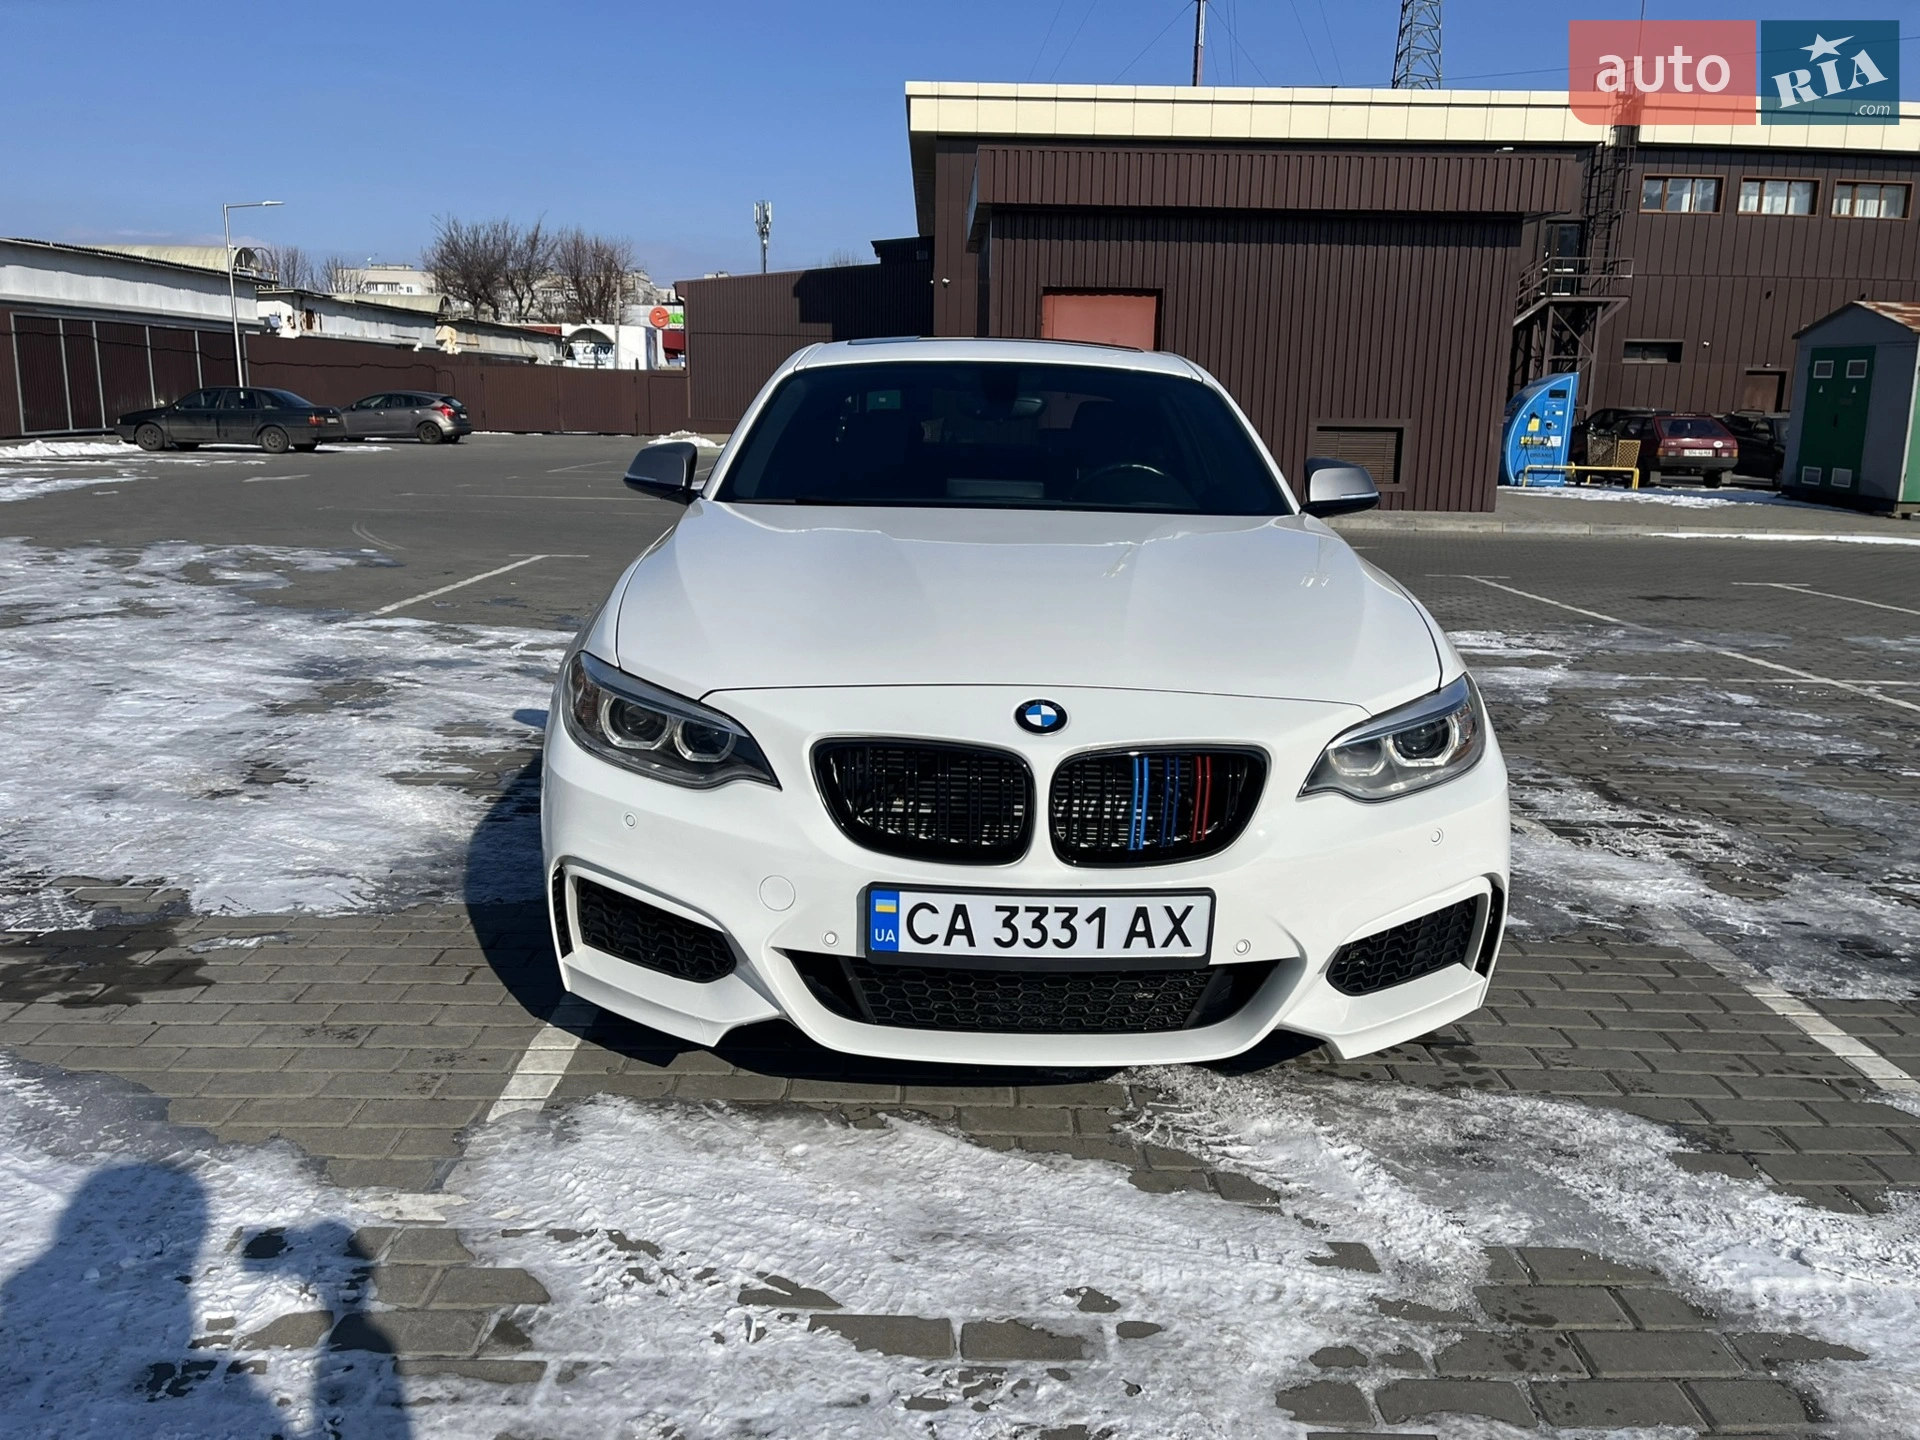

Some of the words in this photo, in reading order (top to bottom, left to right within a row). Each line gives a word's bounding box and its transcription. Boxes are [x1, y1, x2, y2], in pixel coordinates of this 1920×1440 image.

[875, 928, 896, 942] UA
[906, 902, 976, 947] CA
[993, 905, 1107, 949] 3331
[1123, 905, 1194, 948] AX
